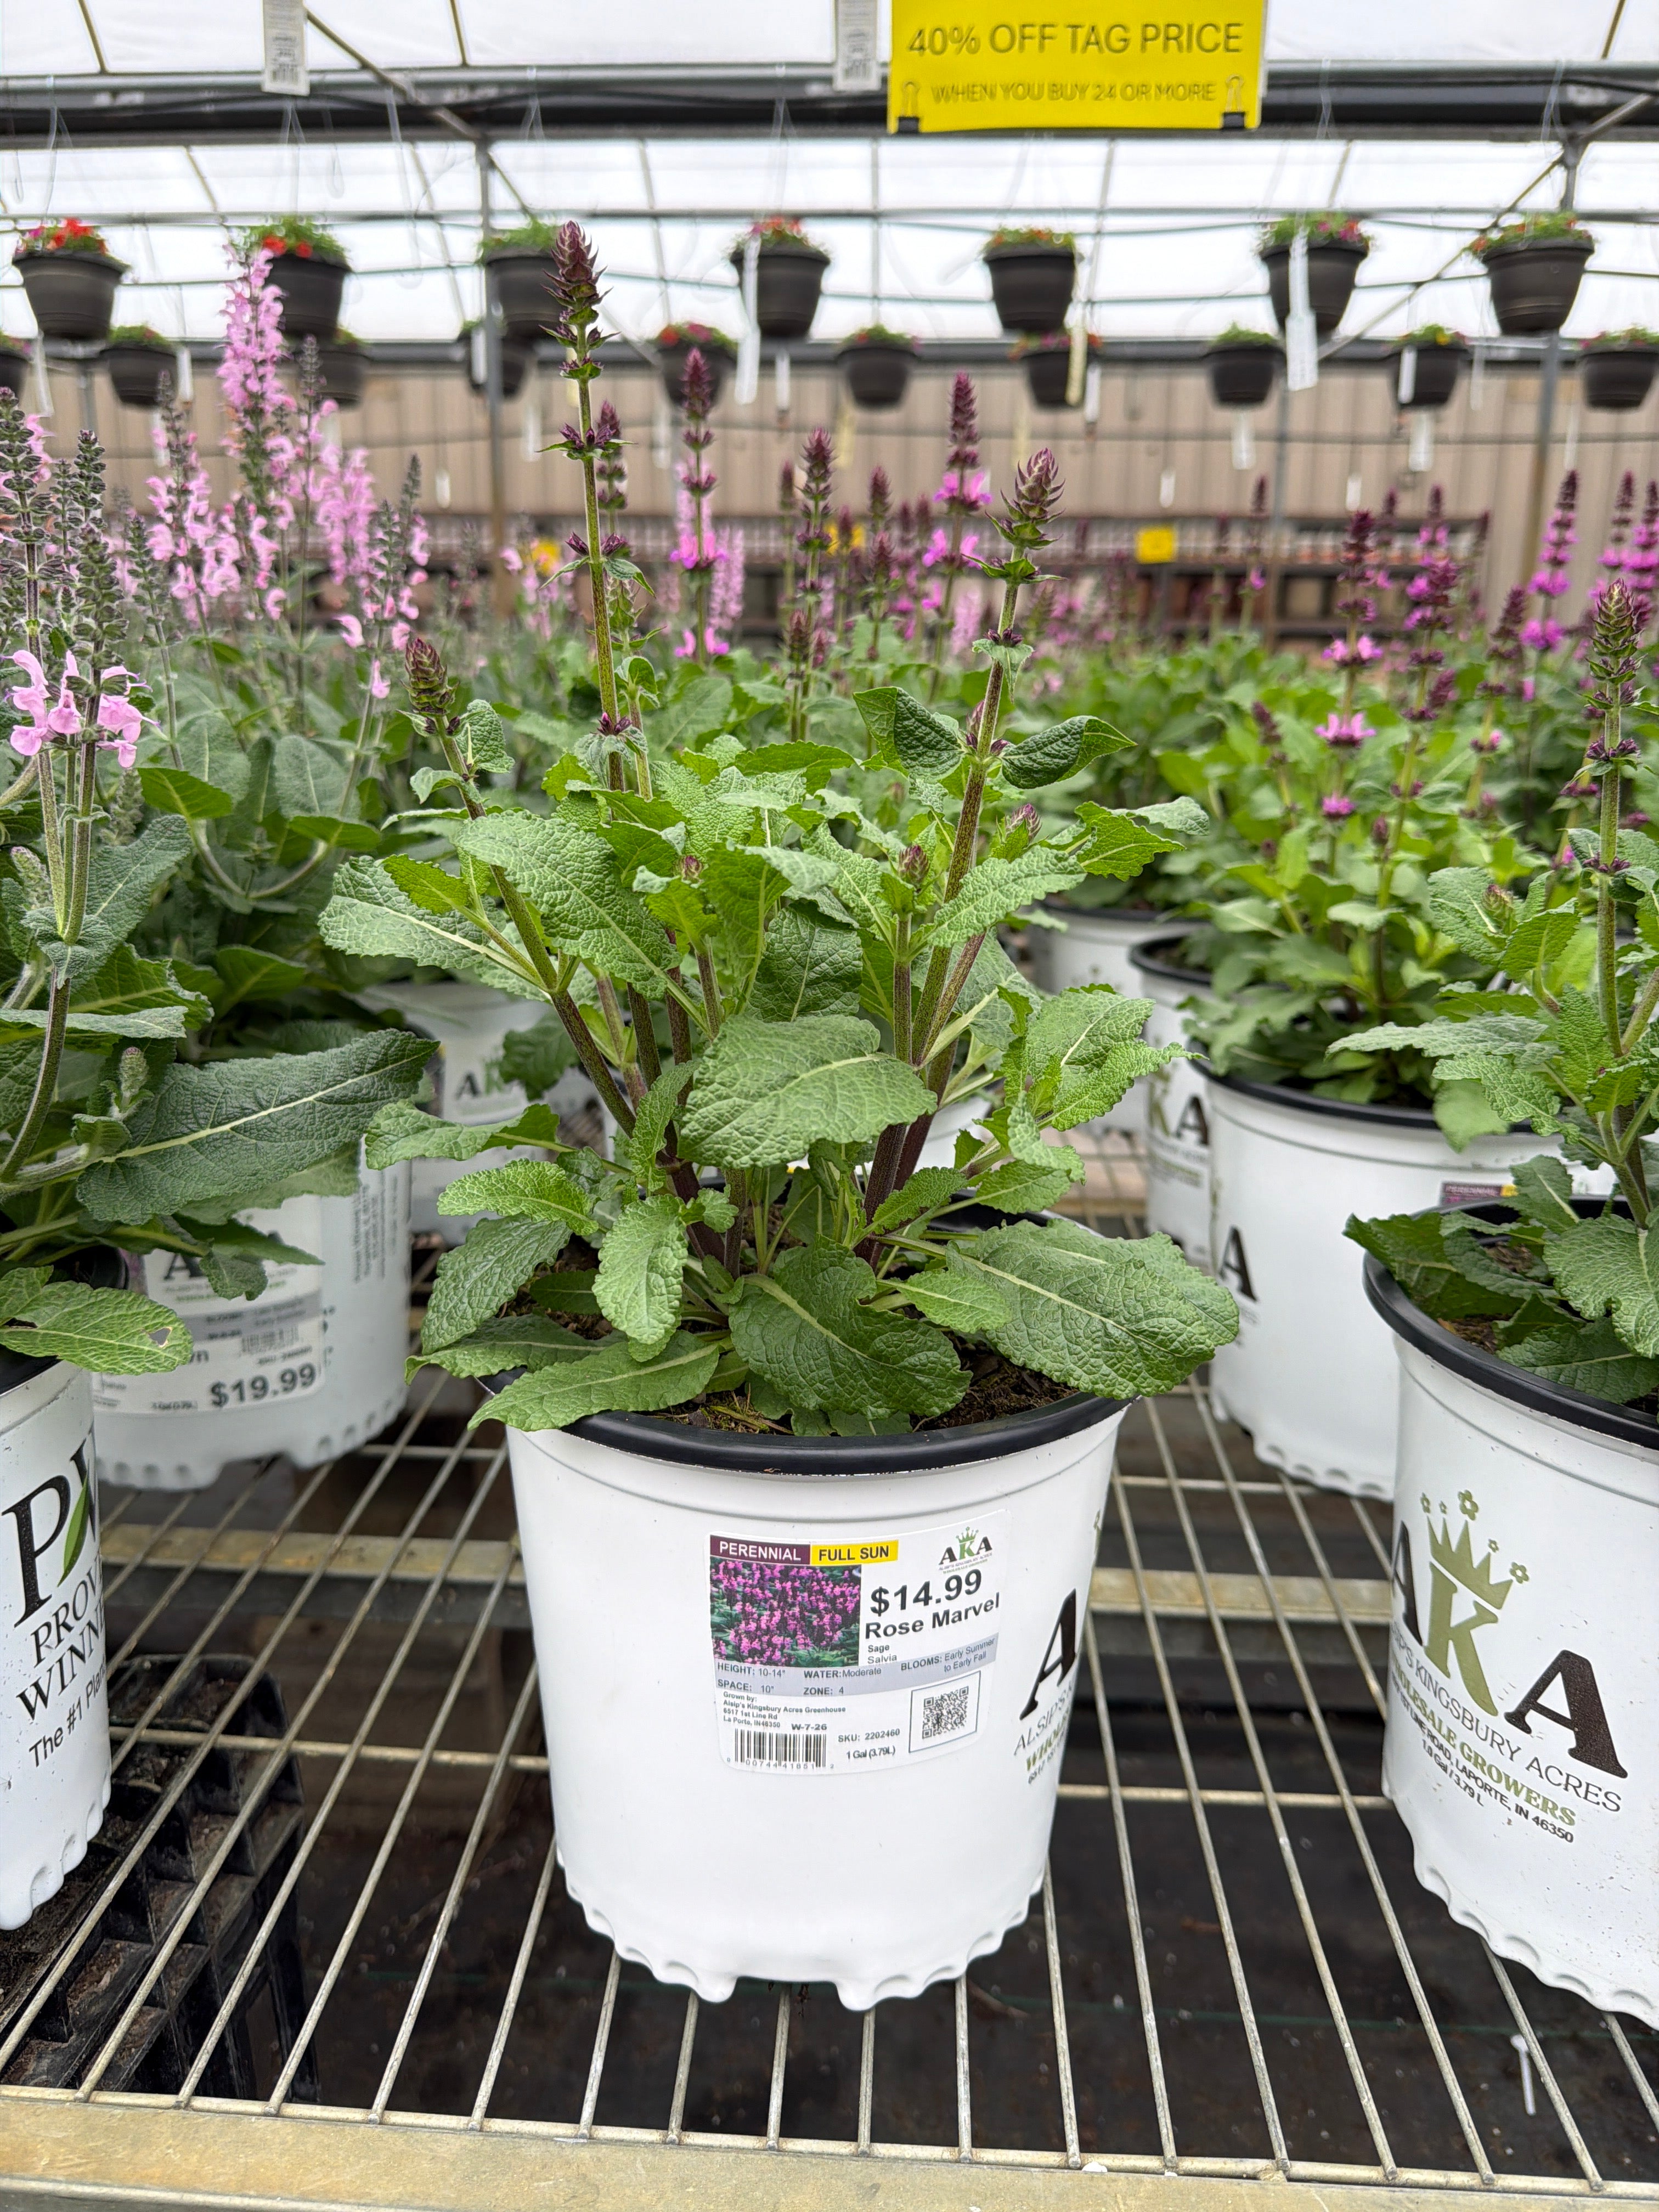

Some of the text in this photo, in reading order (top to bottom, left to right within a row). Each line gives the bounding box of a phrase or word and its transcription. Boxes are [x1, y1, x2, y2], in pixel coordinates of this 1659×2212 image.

[908, 23, 1243, 55] 40% OFF TAG PRICE
[932, 82, 1217, 103] WHEN YOU BUY 24 OR MORE
[210, 1362, 317, 1408] $19.99
[720, 1541, 801, 1561] PERENNIAL
[819, 1545, 889, 1561] FULL SUN
[939, 1536, 992, 1565] AKA
[870, 1568, 981, 1617] $14.99
[865, 1592, 1000, 1639] Rose Marvel
[868, 1644, 890, 1653] Sage
[901, 1638, 995, 1671] BLOOMS: Early Summer
[867, 1654, 897, 1664] Salvia
[953, 1658, 971, 1669] Early
[973, 1651, 986, 1663] Fall
[718, 1662, 786, 1678] HEIGHT: 10-14"
[804, 1667, 882, 1679] WATER: Moderate
[718, 1679, 774, 1693] SPACE: 10"
[723, 1691, 744, 1700] Grown
[804, 1687, 833, 1695] ZONE:
[723, 1700, 745, 1708] Alsip's
[747, 1703, 781, 1713] Kingsbury
[733, 1717, 752, 1726] Porte,
[29, 1727, 63, 1768] The
[67, 1696, 83, 1735] #1
[838, 1728, 900, 1742] SKU: 2202460
[1415, 1658, 1521, 1762] KINGSBURY
[1525, 1757, 1622, 1812] ACRES
[847, 1745, 895, 1759] 1 Gal (3.79L)
[1427, 1731, 1453, 1765] ROAD,
[1455, 1758, 1511, 1811] LAPORTE,
[1515, 1803, 1529, 1820] IN
[1532, 1816, 1574, 1843] 46350
[1434, 1753, 1448, 1774] Gal
[1454, 1774, 1475, 1798] 3.79
[1477, 1794, 1484, 1807] L
[1460, 1741, 1576, 1826] GROWERS
